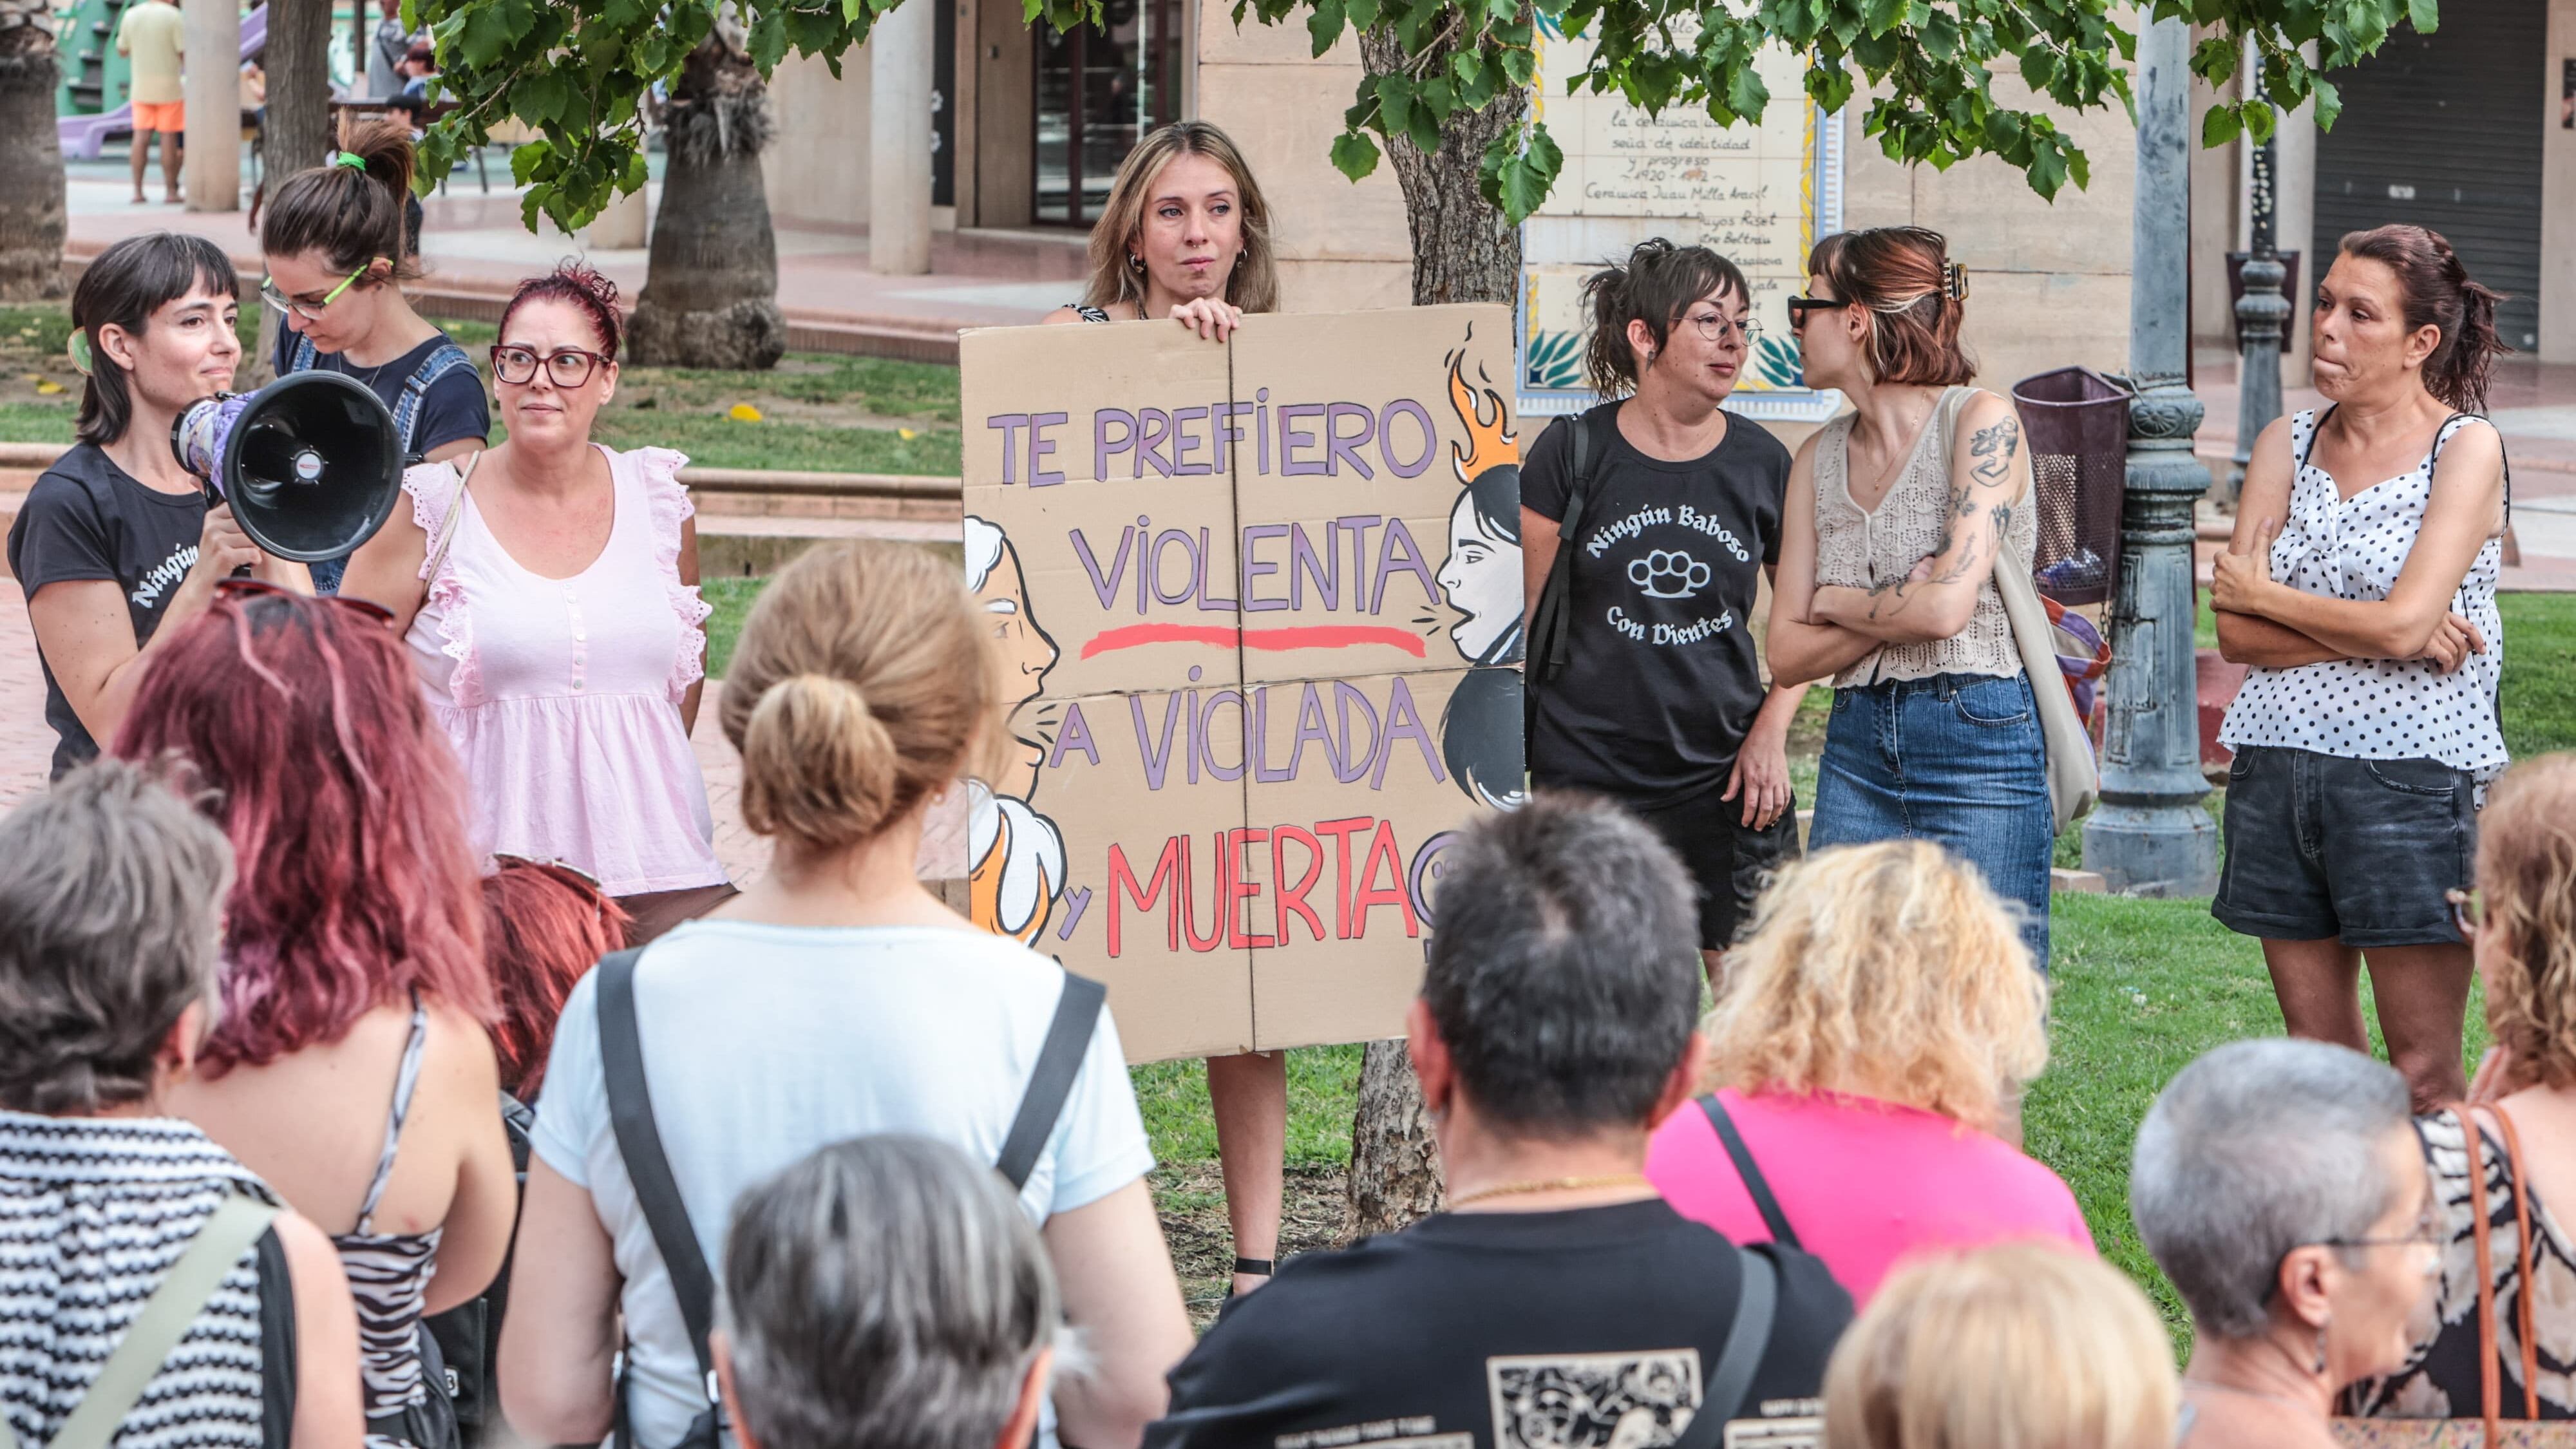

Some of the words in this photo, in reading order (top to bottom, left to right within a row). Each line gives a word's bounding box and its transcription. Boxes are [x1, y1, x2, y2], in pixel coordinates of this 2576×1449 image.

[1611, 109, 1627, 128] la
[1654, 136, 1673, 150] de
[1679, 137, 1750, 150] identidad
[1628, 156, 1636, 172] y
[1647, 155, 1710, 170] progreso
[1653, 185, 1687, 200] Juan
[987, 412, 1068, 488] TE
[1586, 503, 1672, 559] Ningún
[1678, 504, 1750, 562] Baboso
[132, 542, 199, 609] Ningún
[1606, 605, 1645, 641] Con
[1651, 609, 1733, 645] Dientes
[1048, 702, 1101, 769] A
[1106, 815, 1419, 959] MUERTA
